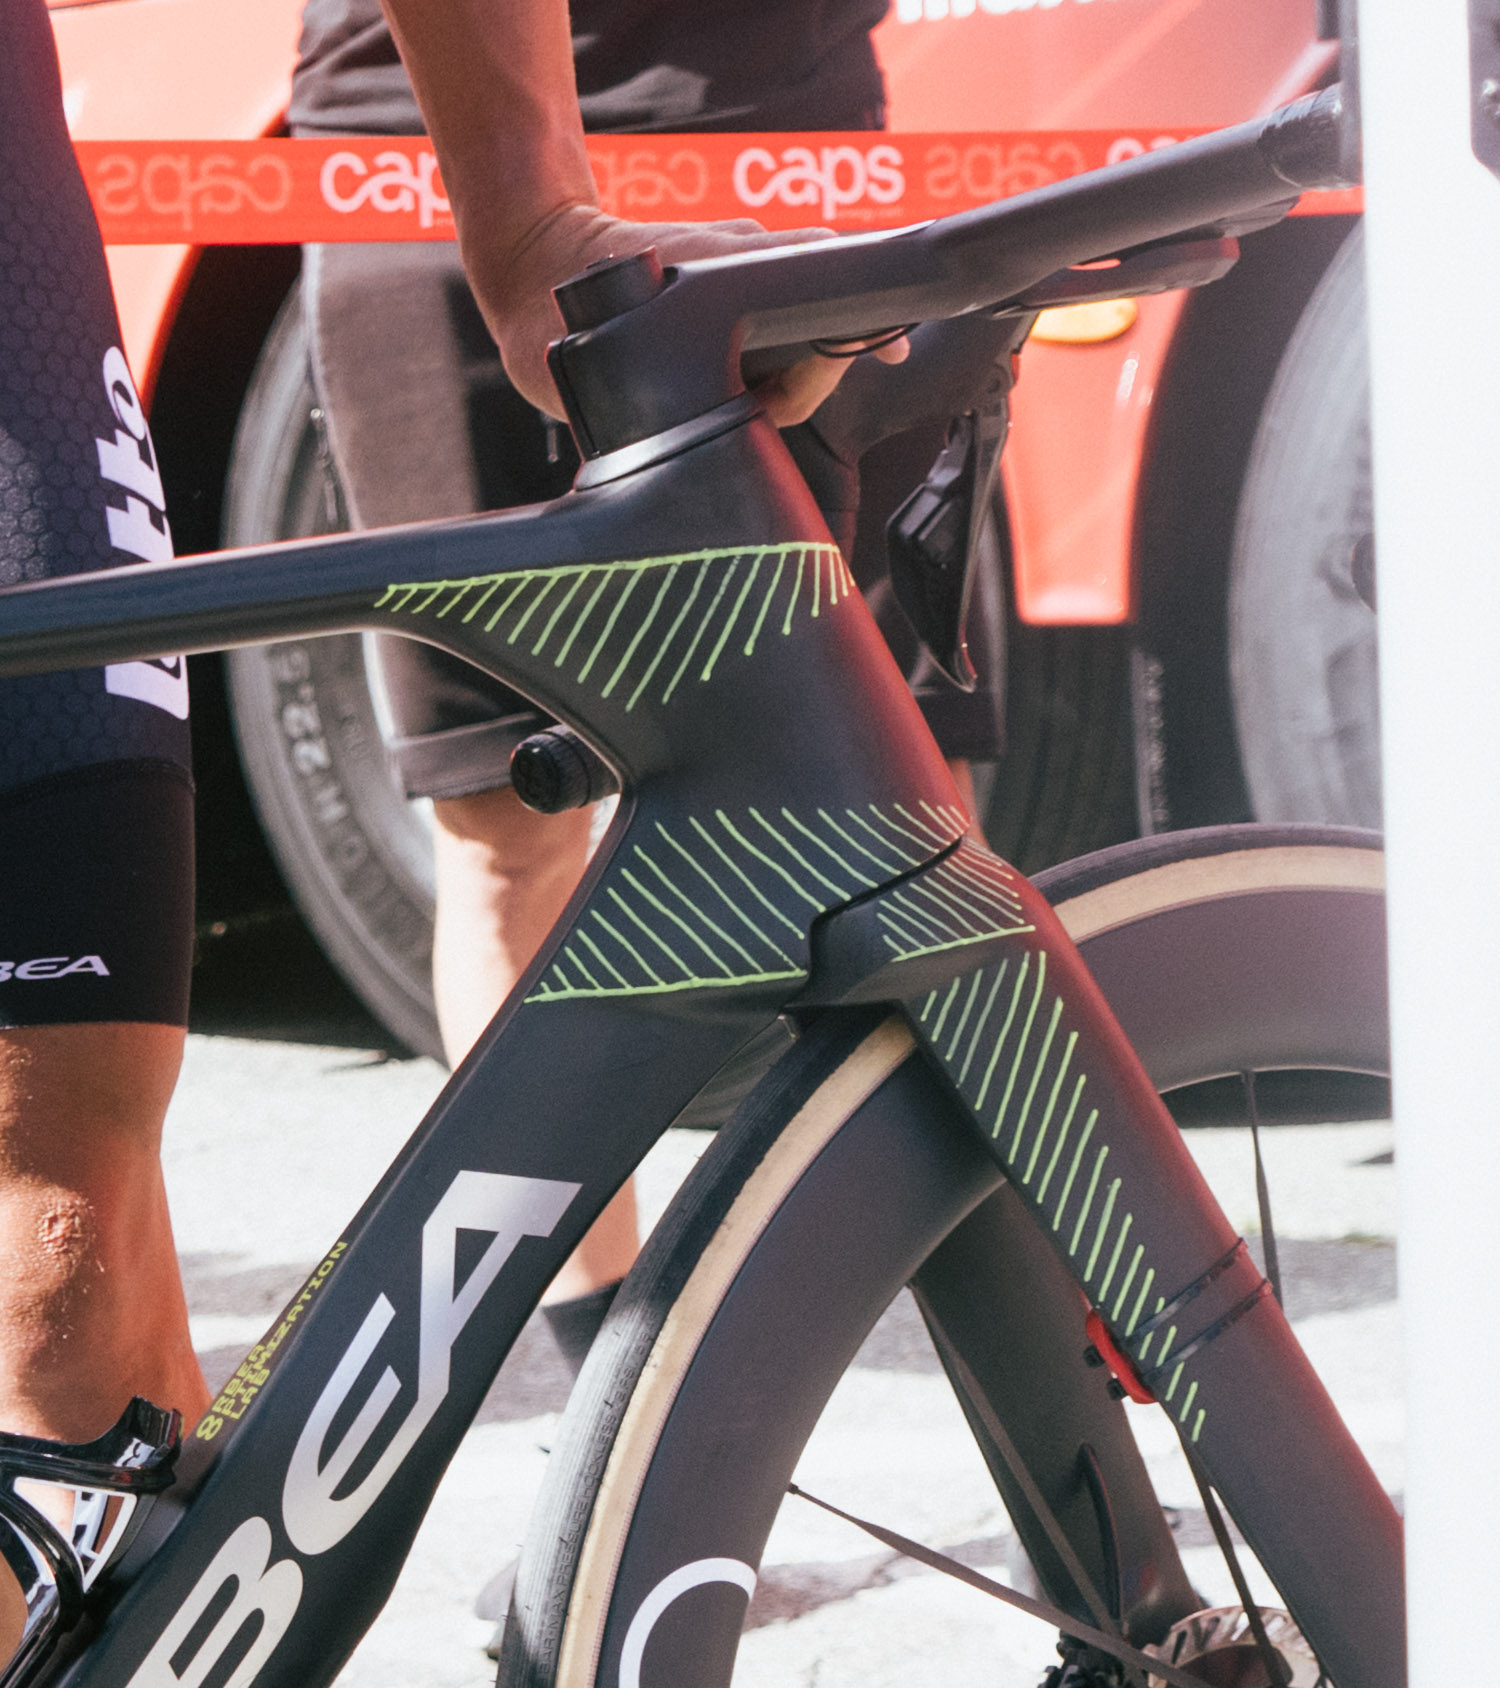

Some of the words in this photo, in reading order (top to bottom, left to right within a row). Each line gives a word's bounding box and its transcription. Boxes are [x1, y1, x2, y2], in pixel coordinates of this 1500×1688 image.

[319, 151, 452, 229] cap
[733, 144, 905, 220] caps
[229, 1368, 271, 1420] LAB
